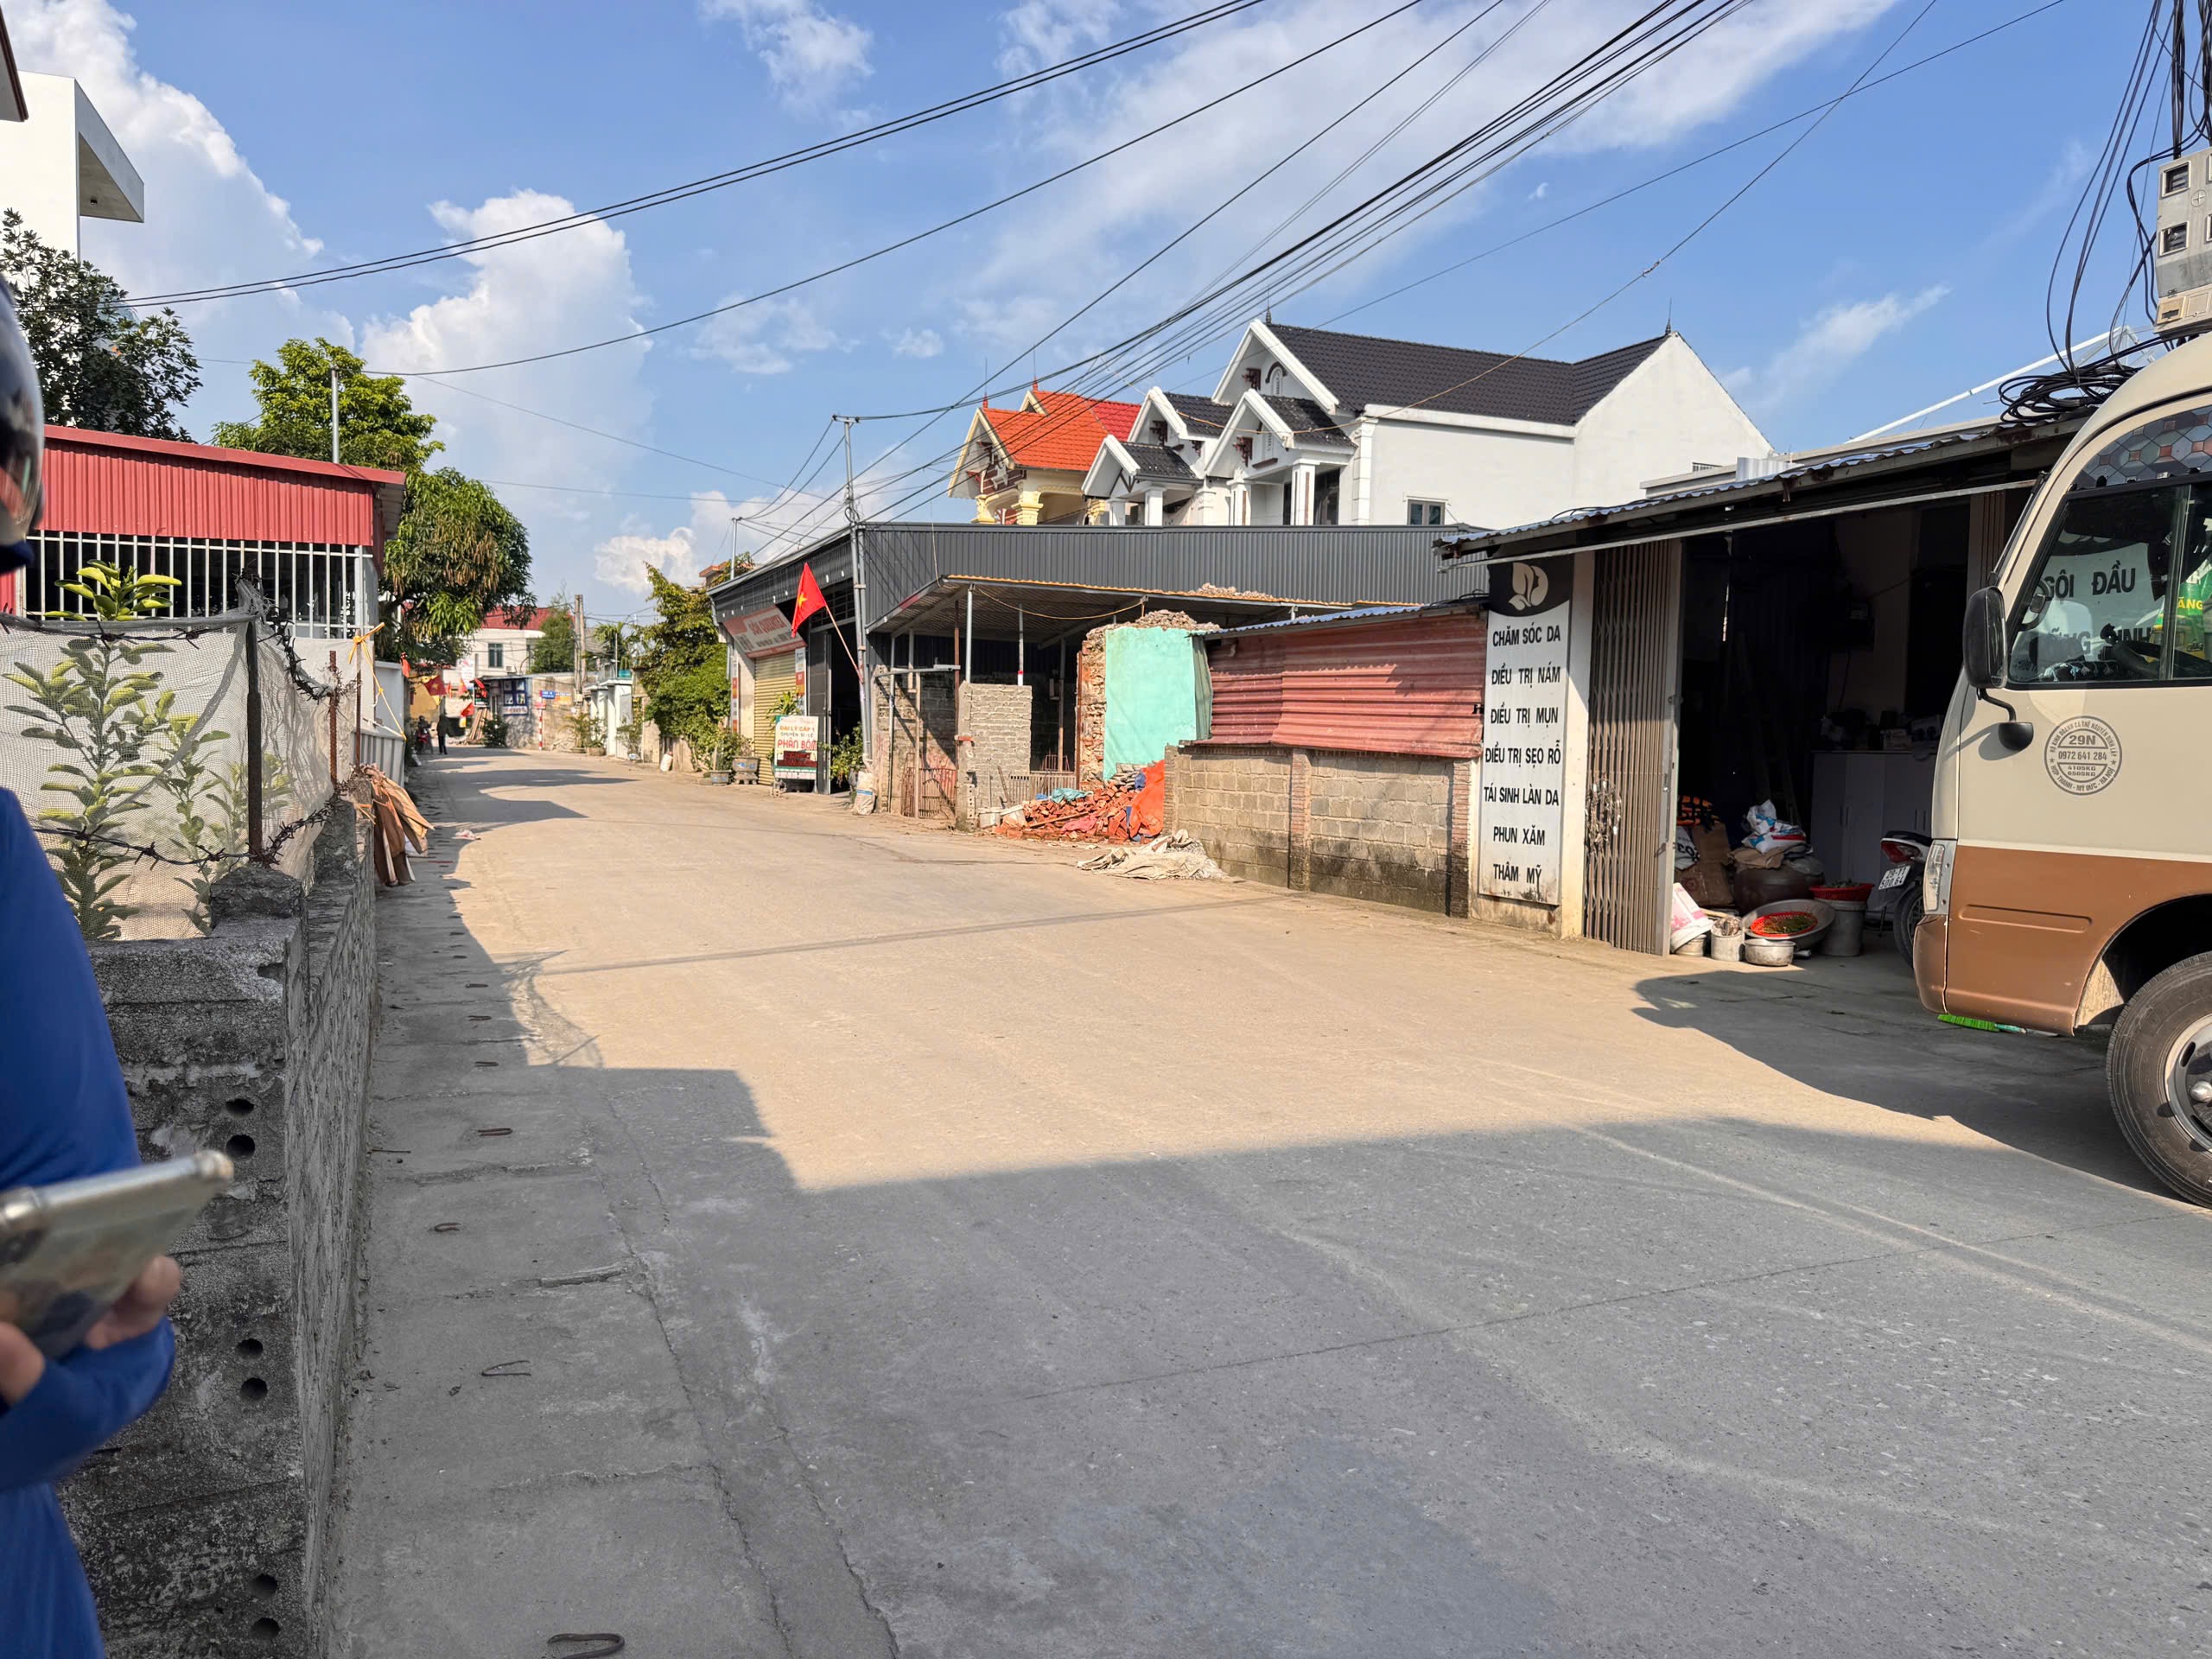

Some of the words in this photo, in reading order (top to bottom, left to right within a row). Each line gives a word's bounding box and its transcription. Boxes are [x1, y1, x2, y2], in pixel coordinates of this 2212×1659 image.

[2091, 560, 2136, 595] ĐẦU
[1492, 625, 1520, 646] CHĂM
[1522, 621, 1542, 644] SÓC
[1547, 625, 1560, 642] DA
[1491, 662, 1512, 684] ĐIỀU
[1518, 667, 1533, 689] TRỊ
[1537, 661, 1560, 683] NÁM
[1491, 702, 1510, 724] ĐIỀU
[1516, 707, 1530, 728] TRỊ
[1535, 707, 1558, 728] MỤN
[2069, 734, 2096, 745] 29N
[1485, 741, 1505, 763] ĐIỀU
[1508, 747, 1522, 767] TRỊ
[1525, 747, 1544, 768] SẸO
[2058, 751, 2075, 760] 0972
[2077, 751, 2090, 760] 641
[2093, 752, 2107, 760] 284
[1484, 782, 1497, 802] TÁI
[1499, 786, 1520, 804] SINH
[1522, 784, 1541, 805] LÀN
[1545, 789, 1560, 806] DA
[1493, 826, 1518, 843] PHUN
[1522, 824, 1545, 846] XĂM
[1526, 864, 1542, 885] MỸ
